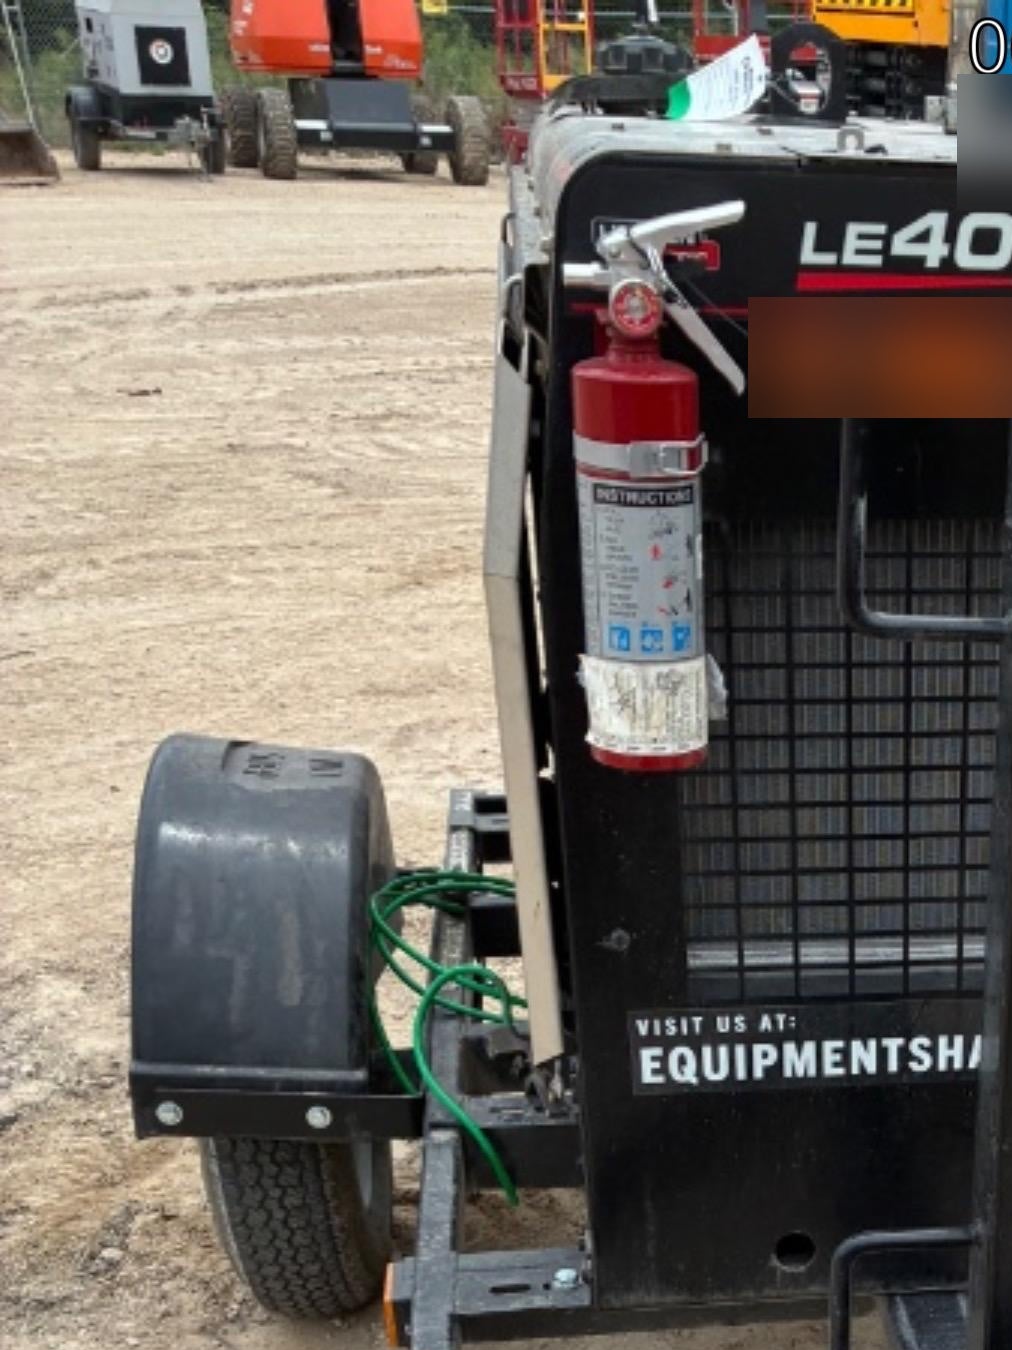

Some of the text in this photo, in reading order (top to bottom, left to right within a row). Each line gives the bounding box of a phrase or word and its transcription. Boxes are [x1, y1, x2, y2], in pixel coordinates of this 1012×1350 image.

[636, 1013, 796, 1036] VISIT US AT:
